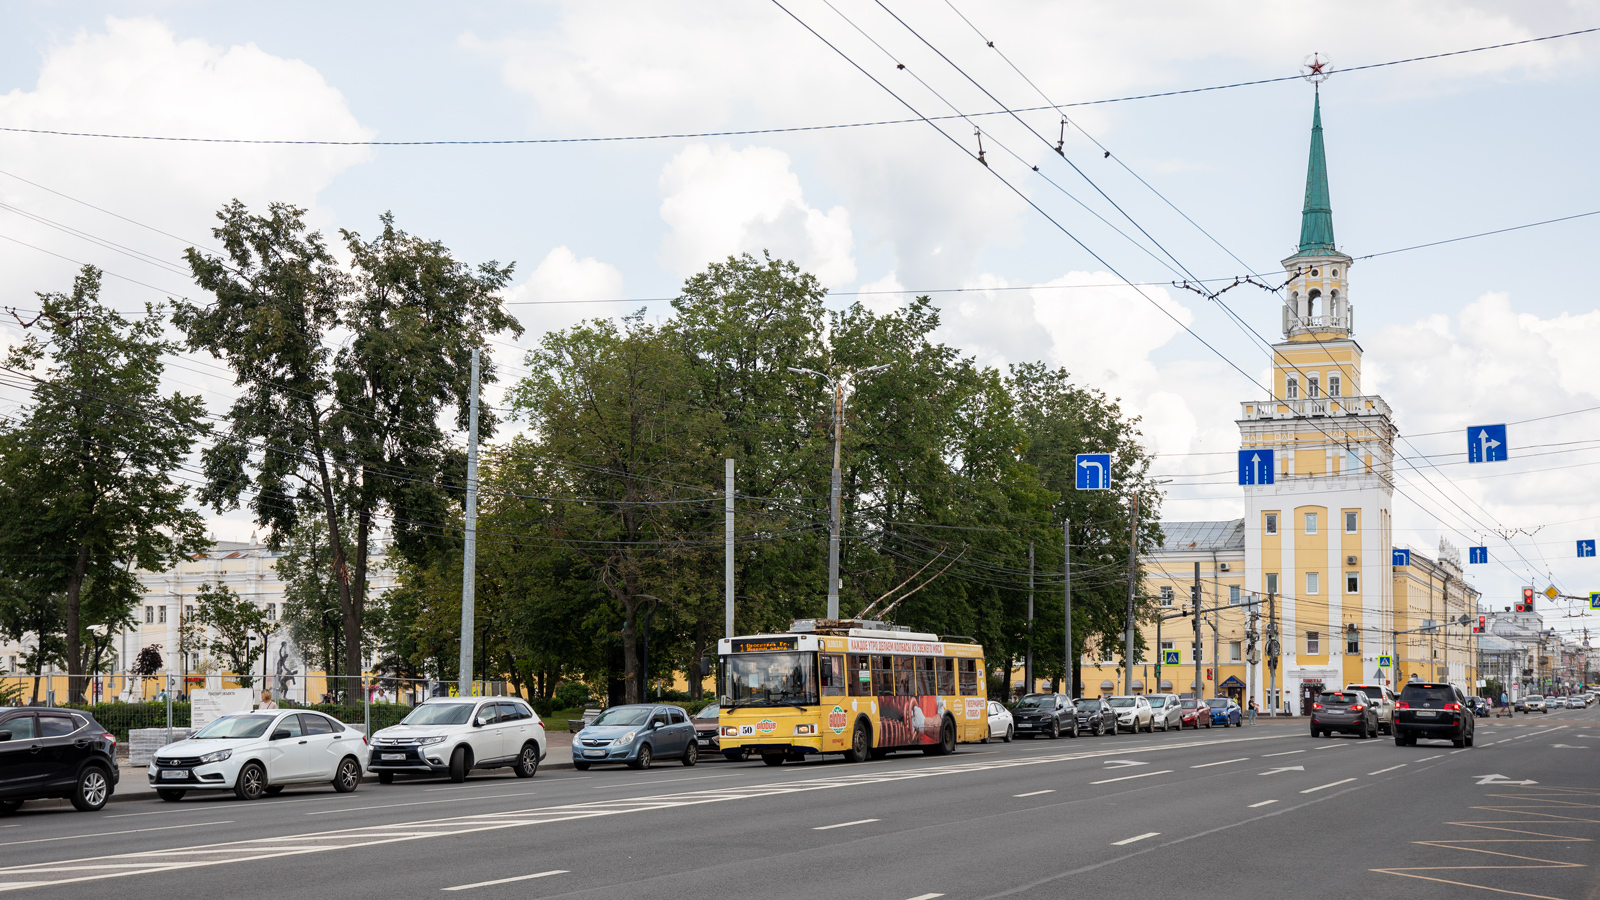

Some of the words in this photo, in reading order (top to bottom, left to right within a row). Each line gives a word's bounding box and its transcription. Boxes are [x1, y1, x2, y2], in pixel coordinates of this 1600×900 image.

[851, 640, 868, 651] КАЖДОЕ
[868, 640, 878, 651] УТРО
[879, 641, 893, 652] ДЕЛАЕМ
[894, 642, 911, 652] КОЛБАСЫ
[912, 643, 917, 653] ИЗ
[917, 643, 932, 653] СВЕЖЕГО
[933, 644, 943, 654] МЯСА
[742, 726, 753, 734] 50
[756, 721, 777, 730] globus
